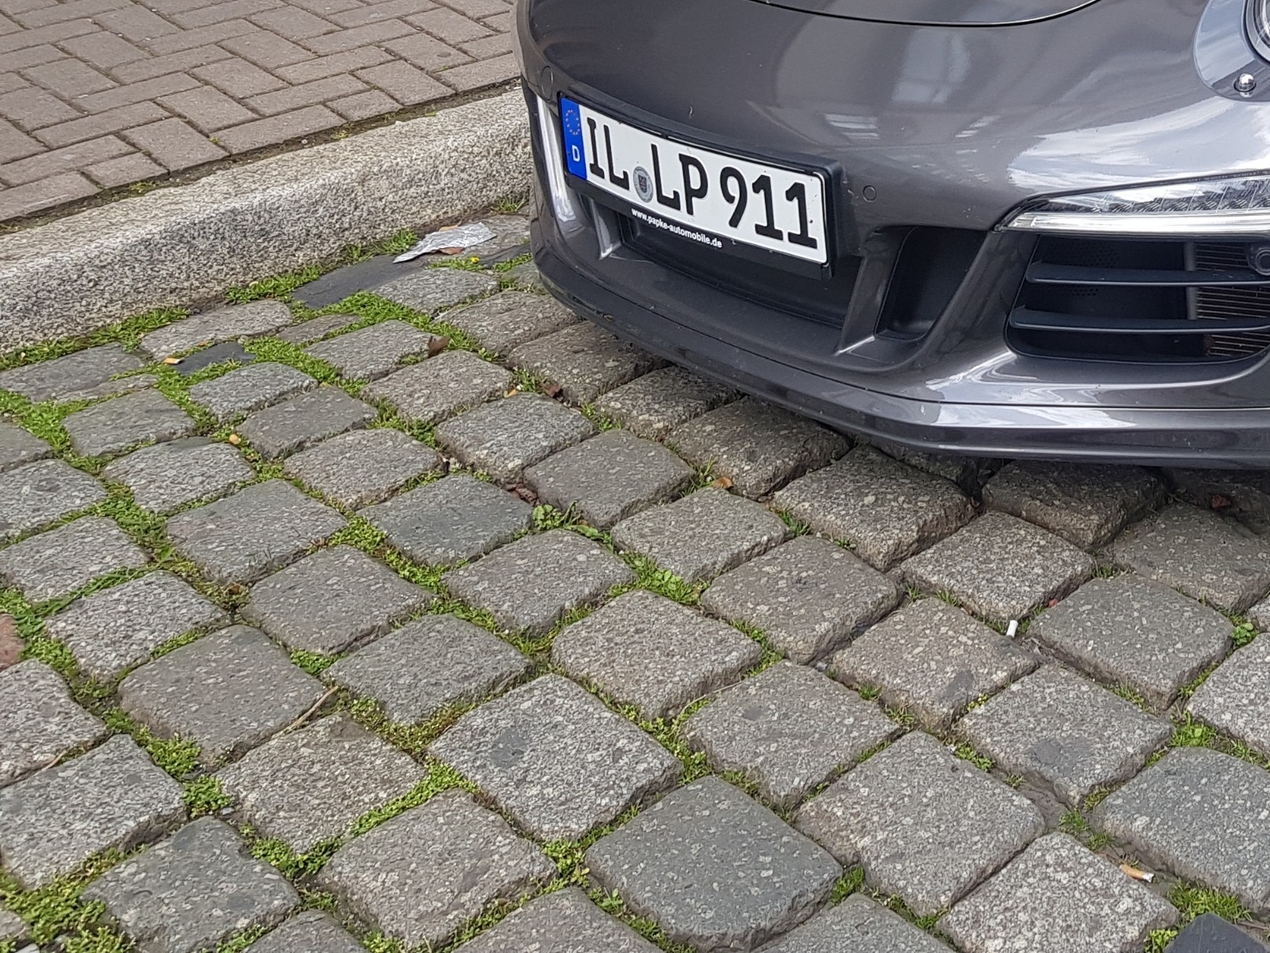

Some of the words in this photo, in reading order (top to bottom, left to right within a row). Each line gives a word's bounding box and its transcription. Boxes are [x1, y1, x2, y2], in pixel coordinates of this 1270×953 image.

[571, 144, 581, 163] D
[586, 117, 630, 191] IL
[650, 143, 709, 216] LP
[719, 166, 818, 250] 911
[631, 207, 723, 248] www.papke-automobile.de
